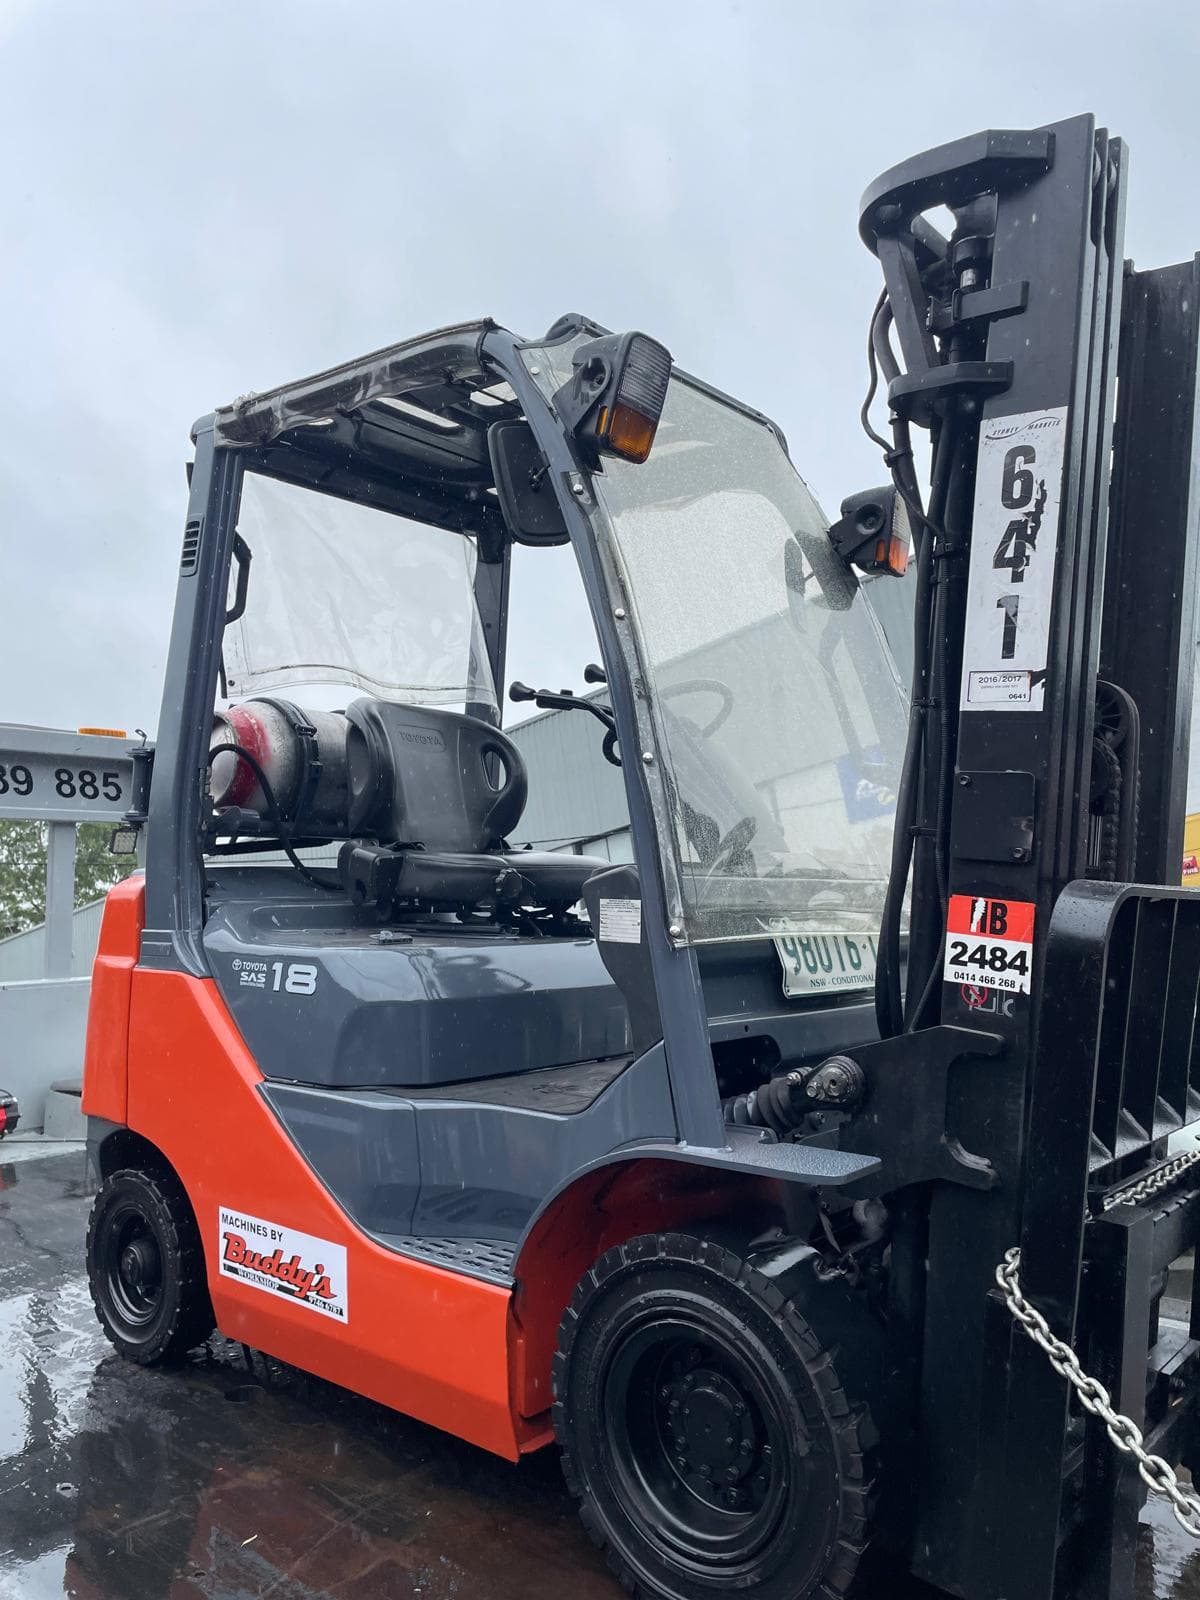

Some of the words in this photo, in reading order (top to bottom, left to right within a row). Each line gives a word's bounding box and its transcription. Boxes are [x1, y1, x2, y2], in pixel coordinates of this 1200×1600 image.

[978, 675, 1022, 684] 2016/2017
[400, 731, 442, 745] TOYOTA
[54, 768, 122, 802] 885
[242, 961, 267, 971] TOYOTA
[949, 941, 1029, 977] 2484
[240, 971, 266, 983] SAS
[272, 962, 318, 995] 18
[810, 979, 827, 988] NSW
[954, 971, 976, 982] 0414
[978, 975, 996, 985] 466
[998, 978, 1016, 989] 268
[221, 1213, 268, 1238] MACHINES
[270, 1229, 284, 1243] BY
[223, 1231, 337, 1300] Buddy's
